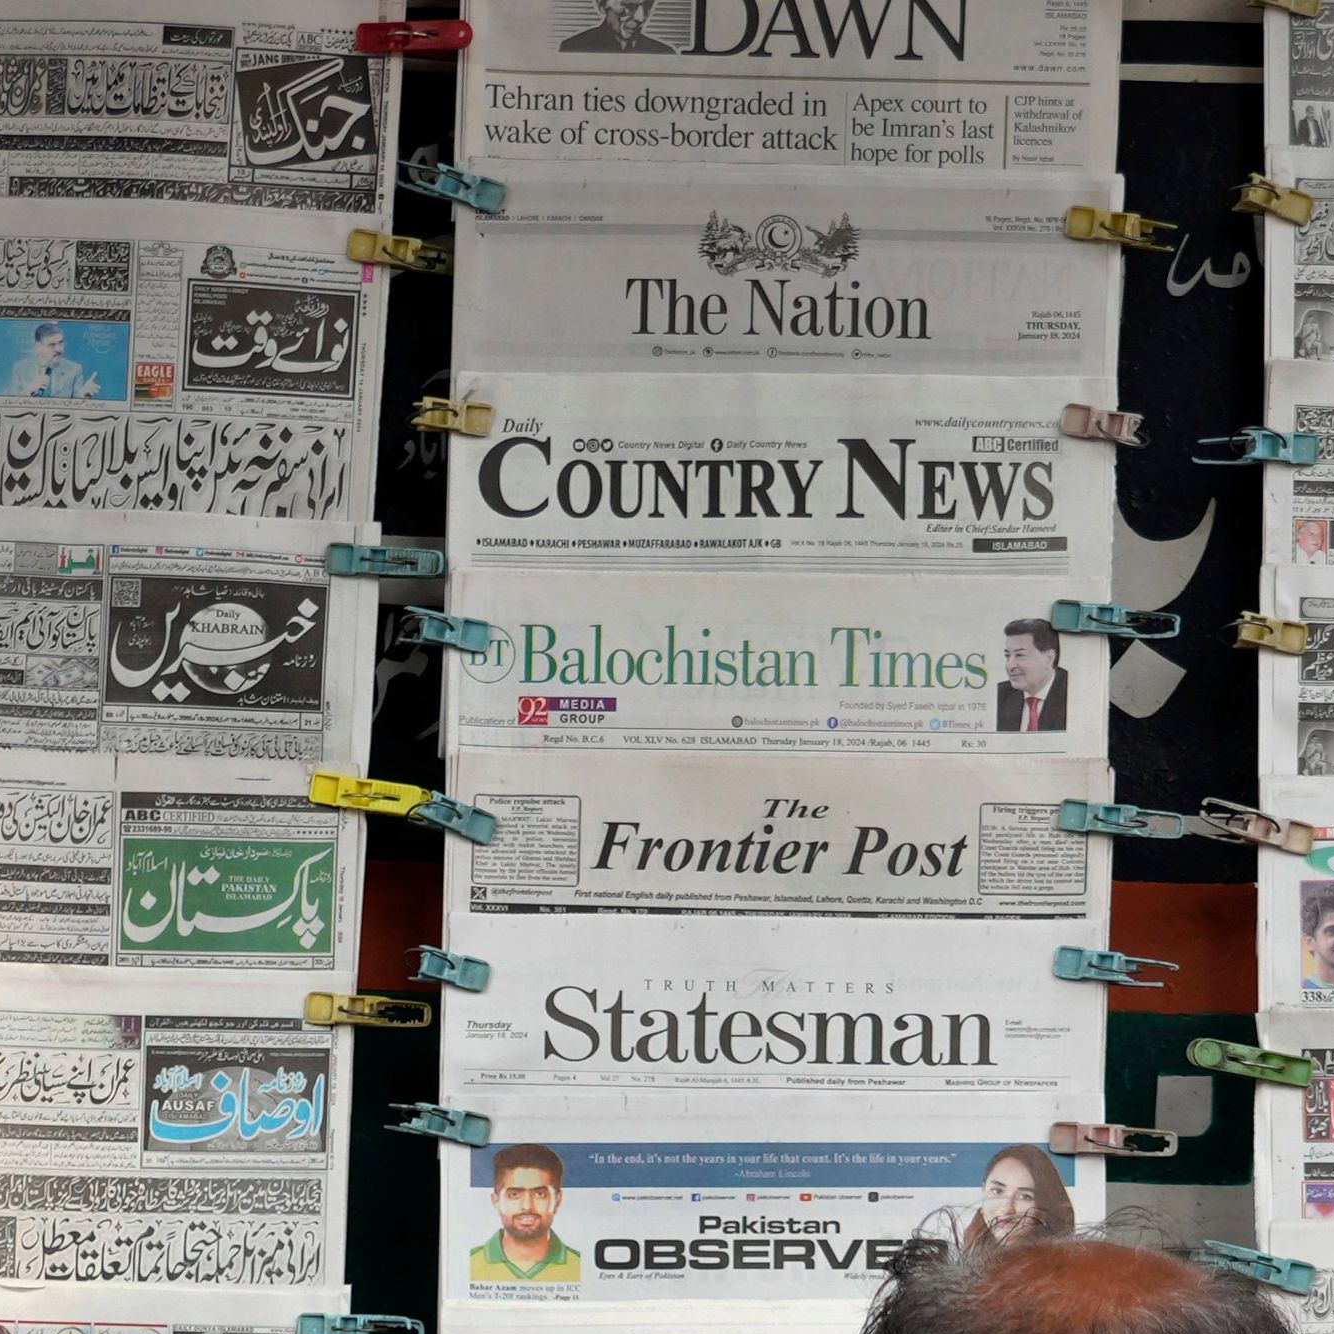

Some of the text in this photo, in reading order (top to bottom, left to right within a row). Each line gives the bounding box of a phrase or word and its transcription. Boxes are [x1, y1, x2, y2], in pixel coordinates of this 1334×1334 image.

[680, 0, 966, 62] DAWN
[1013, 64, 1086, 73] www.dawn.com
[485, 83, 828, 121] Tehran ties downgraded in
[852, 93, 987, 117] Apex court to
[1014, 96, 1036, 107] CJP
[1038, 96, 1063, 107] hints
[245, 58, 371, 165] جنگ
[1014, 109, 1084, 120] withdrawal of
[852, 118, 875, 136] be
[962, 120, 994, 139] last
[1015, 123, 1076, 133] Kalashnikov
[485, 120, 838, 153] wake of cross-border attack
[1013, 136, 1053, 147] licences
[851, 142, 984, 169] hope for polls
[626, 277, 931, 341] The Nation
[136, 364, 173, 381] EAGLE
[503, 417, 544, 437] Daily
[914, 417, 1061, 432] www.dailycountrynews.co
[975, 438, 1060, 454] ABC Certified
[478, 436, 1054, 524] COUNTRY NEWS
[482, 538, 528, 549] ISLAMABAD
[536, 539, 570, 549] KARACHI
[577, 539, 621, 549] PESHAWAR
[628, 539, 692, 549] MUZAFFARABAD
[699, 539, 747, 549] RAWALAKOT
[991, 540, 1047, 551] ISLAMABAD
[216, 610, 241, 621] Daily
[191, 623, 264, 635] KHABRAIN
[518, 623, 988, 690] Balochistan Times
[559, 699, 606, 710] MEDIA
[559, 713, 605, 725] GROUP
[125, 810, 215, 822] ABC CERTIFIED
[763, 798, 829, 821] The
[591, 821, 828, 877] Frontier
[846, 826, 968, 879] Post
[221, 884, 277, 893] PAKISTAN
[123, 847, 333, 950] پاکستان
[644, 979, 896, 995] TRUTH MATTERS
[465, 1020, 512, 1033] Thursday
[543, 986, 998, 1066] Statesman
[786, 1076, 826, 1086] Published
[149, 1067, 324, 1143] اوصاف
[162, 1100, 215, 1111] AUSAF
[698, 1215, 841, 1235] Pakistan
